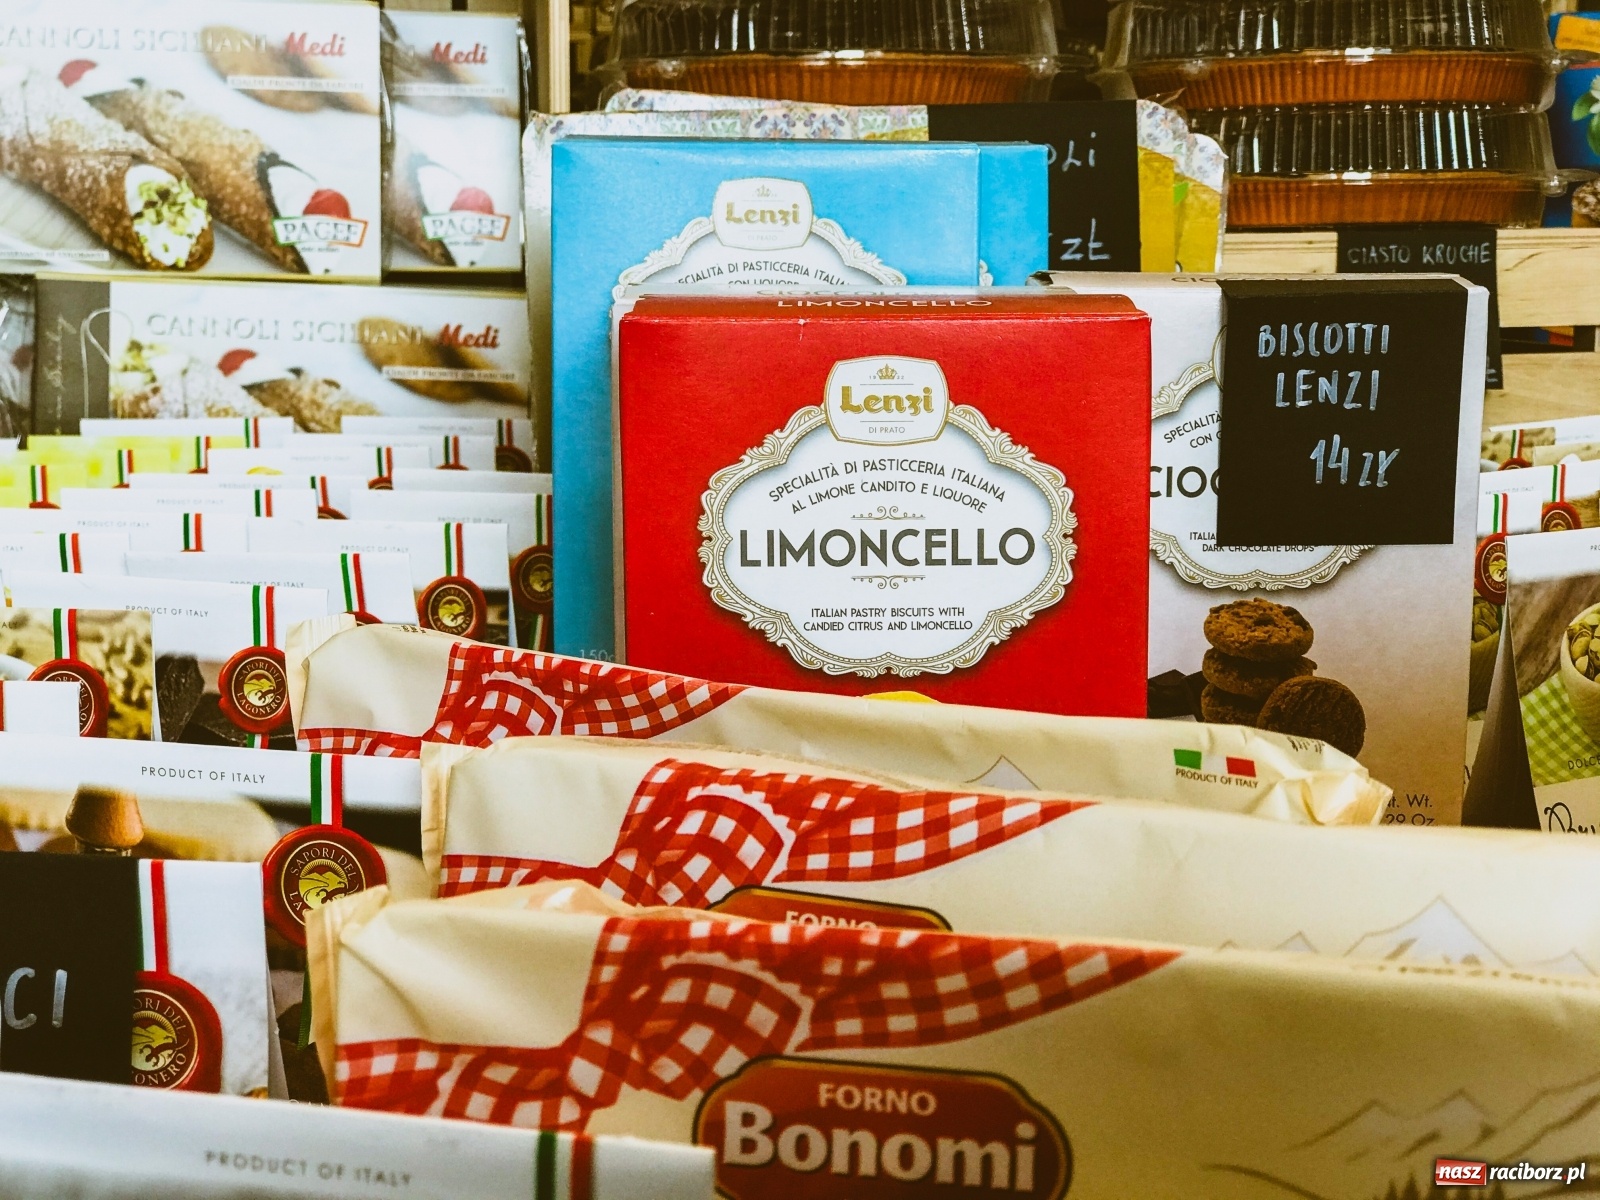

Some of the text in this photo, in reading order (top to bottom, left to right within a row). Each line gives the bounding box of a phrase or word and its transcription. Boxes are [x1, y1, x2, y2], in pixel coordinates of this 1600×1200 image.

[0, 26, 121, 51] ANNOLI
[283, 32, 346, 57] Medi
[431, 42, 488, 64] Medi
[725, 202, 800, 226] Lenzi
[1347, 242, 1492, 265] CIASTO KRUCHE
[728, 262, 739, 273] DI
[743, 261, 810, 277] PASTICCERIA
[777, 300, 993, 308] LIMONCELLO
[147, 313, 424, 346] CANNOLI SICILIANI
[436, 322, 500, 350] Medi
[1257, 321, 1390, 357] BISCOTTI
[840, 386, 934, 416] Lenzi
[1275, 369, 1380, 411] LENZI
[868, 426, 906, 434] DI PRATO
[1189, 433, 1213, 449] CON
[1309, 433, 1350, 485] 14
[768, 458, 1007, 503] SPECIALITÀ DI PASTICCERIA ITALIANA
[791, 480, 989, 515] AL LIMONE CANDITO E LIQUORE
[739, 527, 1036, 567] LIMONCELLO
[1228, 545, 1281, 553] CHOCOLATE
[171, 608, 182, 616] OF
[186, 609, 209, 618] ITALY
[811, 608, 965, 618] ITALIAN PASTRY BISCUITS WITH
[803, 621, 973, 632] CANDIED CITRUS AND LIMONCELLO
[238, 661, 267, 681] SAPORI
[237, 692, 282, 715] LAGONERO
[141, 766, 266, 784] PRODUCT OF ITALY
[1175, 768, 1259, 789] PRODUCT OF ITALY
[1406, 794, 1433, 808] Wt.
[289, 847, 358, 880] SAPORI DEL
[4, 966, 68, 1030] CI
[162, 1005, 186, 1032] DEL
[132, 1051, 187, 1086] ONERO
[818, 1082, 938, 1117] FORNO
[722, 1099, 1038, 1193] Bonomi
[204, 1149, 413, 1188] PRODUCT OF ITALY
